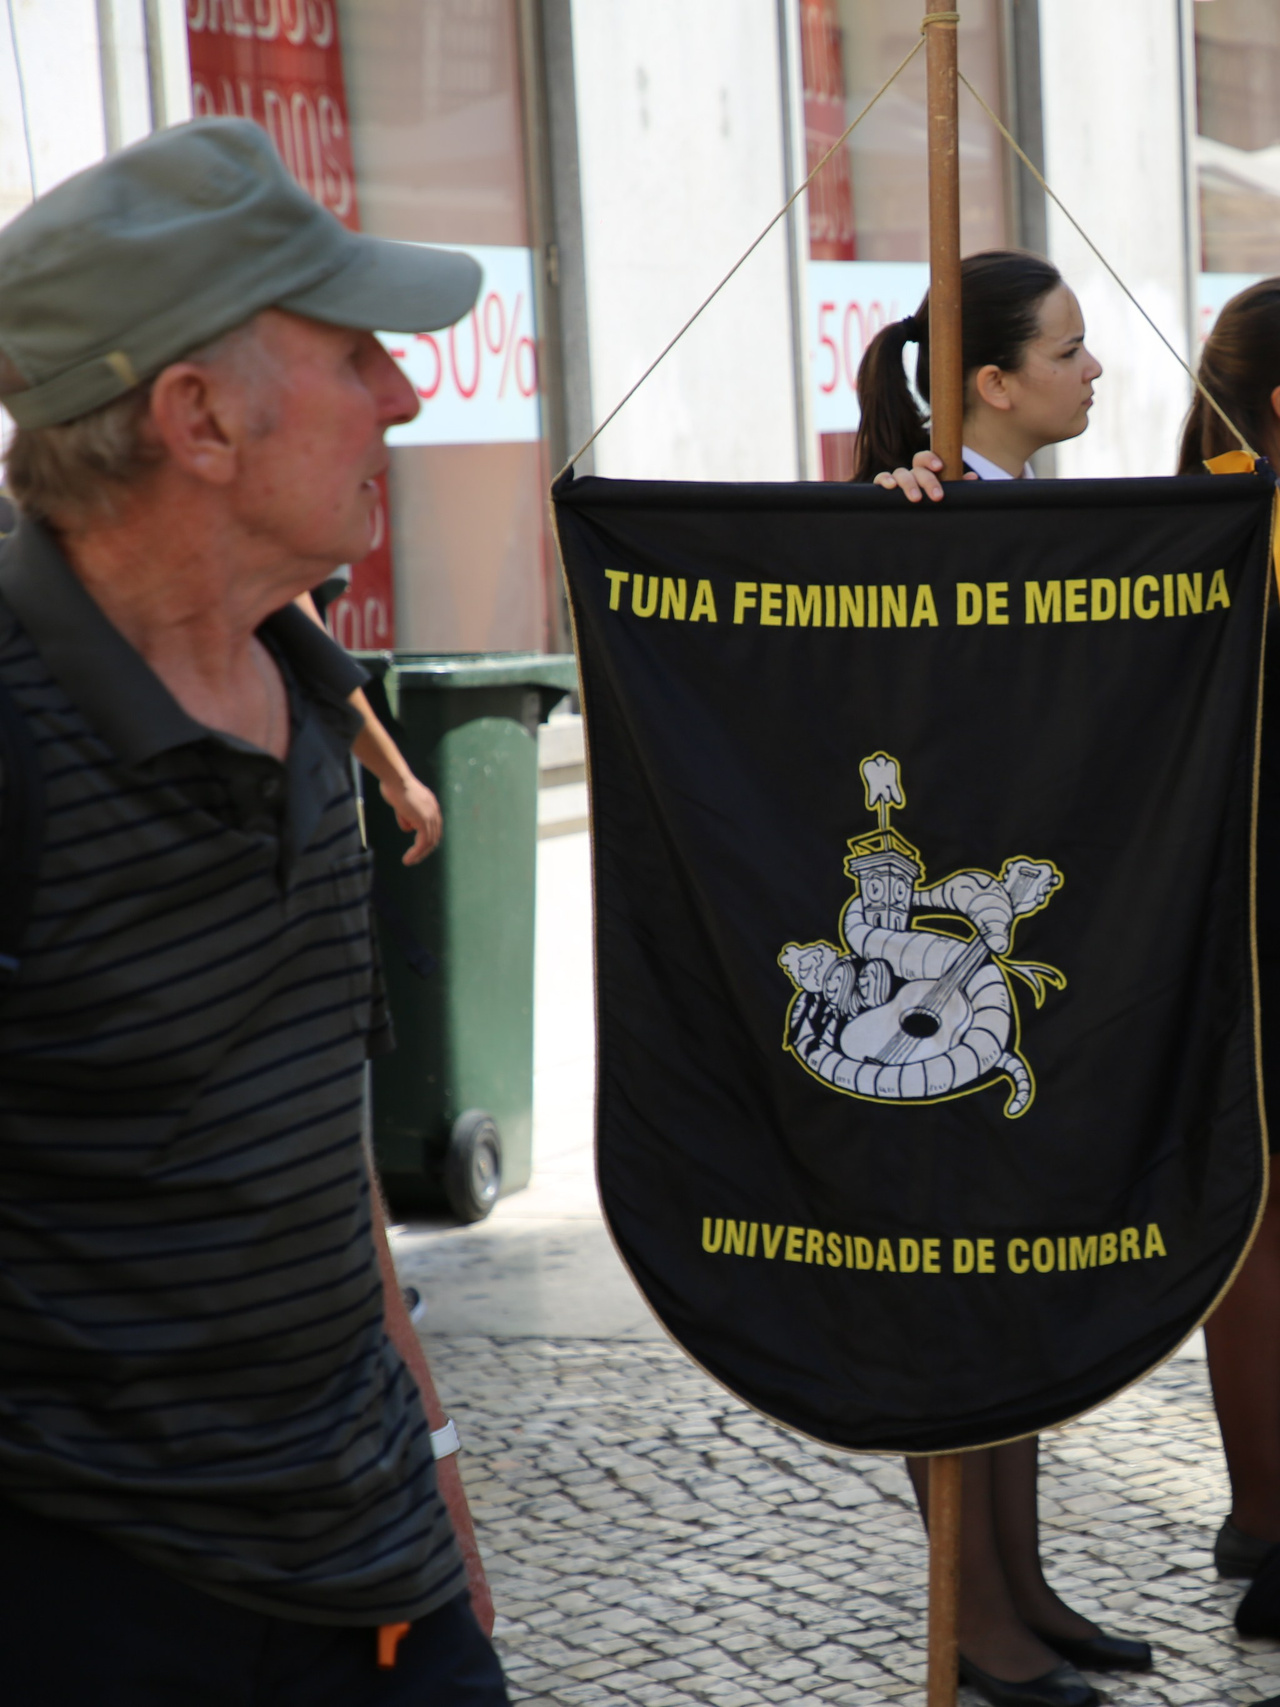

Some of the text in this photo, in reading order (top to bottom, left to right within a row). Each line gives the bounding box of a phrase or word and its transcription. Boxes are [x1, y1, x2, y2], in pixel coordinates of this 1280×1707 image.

[605, 569, 1230, 628] TUNA FEMININA DE MEDICINA
[702, 1218, 1166, 1273] UNIVERSIDADE DE COIMBRA
